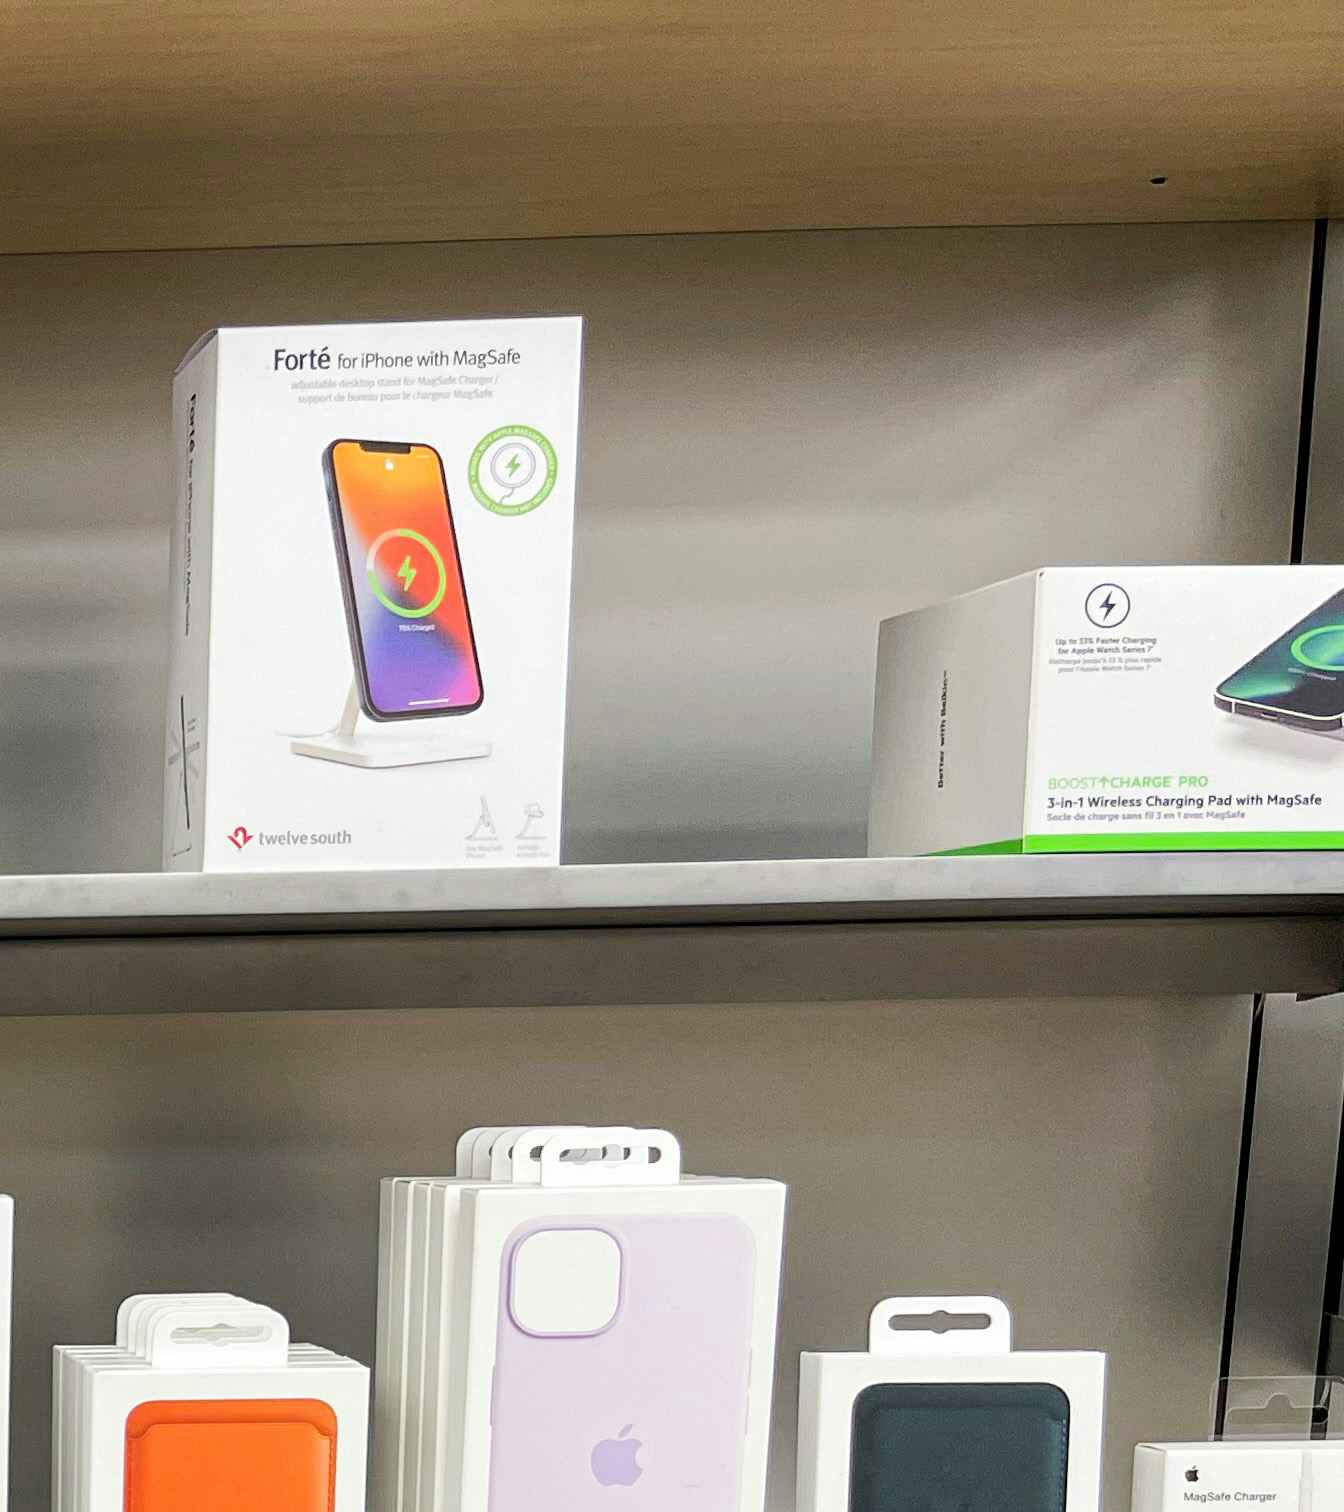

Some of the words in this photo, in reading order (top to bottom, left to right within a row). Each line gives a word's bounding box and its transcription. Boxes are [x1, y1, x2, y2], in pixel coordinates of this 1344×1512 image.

[274, 346, 331, 371] Forté
[338, 355, 357, 369] for
[362, 353, 413, 369] iPhone
[417, 351, 449, 367] with
[454, 349, 520, 369] MagSafe
[1179, 776, 1208, 787] PRO
[1048, 797, 1083, 808] 3-in-1
[1088, 796, 1142, 807] Wireless
[1146, 795, 1203, 810] Charging
[1208, 795, 1232, 807] Pad
[1237, 795, 1264, 806] with
[1267, 794, 1321, 809] MagSafe
[1184, 1493, 1230, 1503] MagSafe
[1234, 1493, 1276, 1503] Charger
